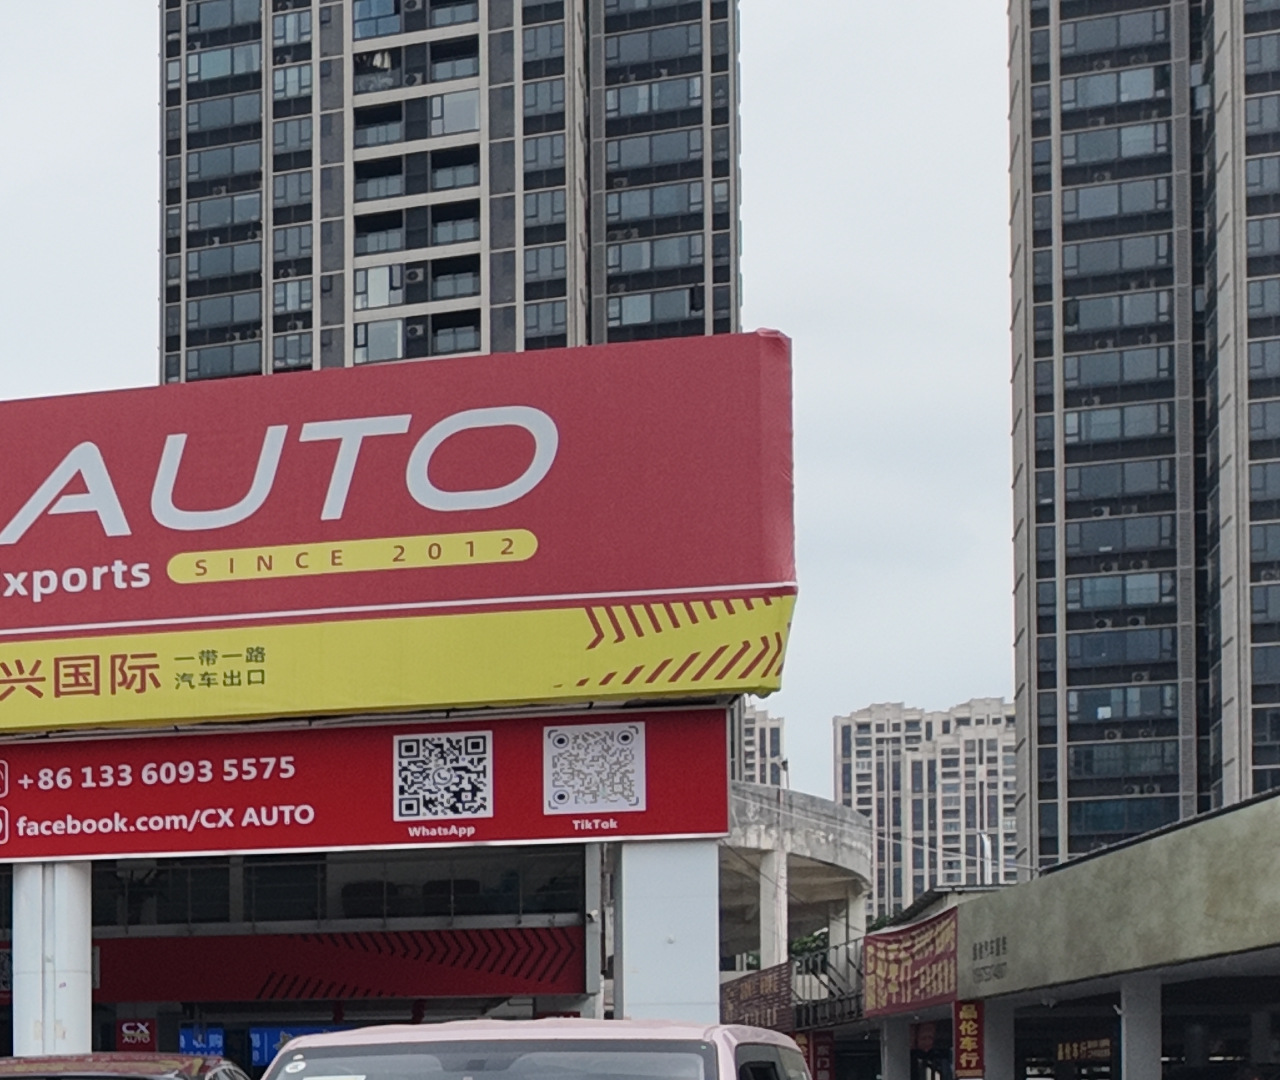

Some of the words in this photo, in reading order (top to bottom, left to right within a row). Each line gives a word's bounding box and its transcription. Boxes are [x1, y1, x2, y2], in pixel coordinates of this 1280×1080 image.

[194, 548, 343, 577] SINCE
[392, 537, 515, 562] 2012
[174, 645, 266, 668] 一带一路
[174, 668, 266, 690] 汽车出口
[17, 768, 72, 791] +86
[81, 764, 132, 788] 133
[141, 760, 213, 785] 6093
[222, 756, 295, 781] 5575
[16, 808, 234, 837] facebook.com/CX
[241, 804, 315, 827] AUTO
[408, 823, 476, 838] WhatsApp
[572, 817, 618, 831] TikTok
[122, 1022, 149, 1035] CX
[122, 1035, 151, 1044] AUTO
